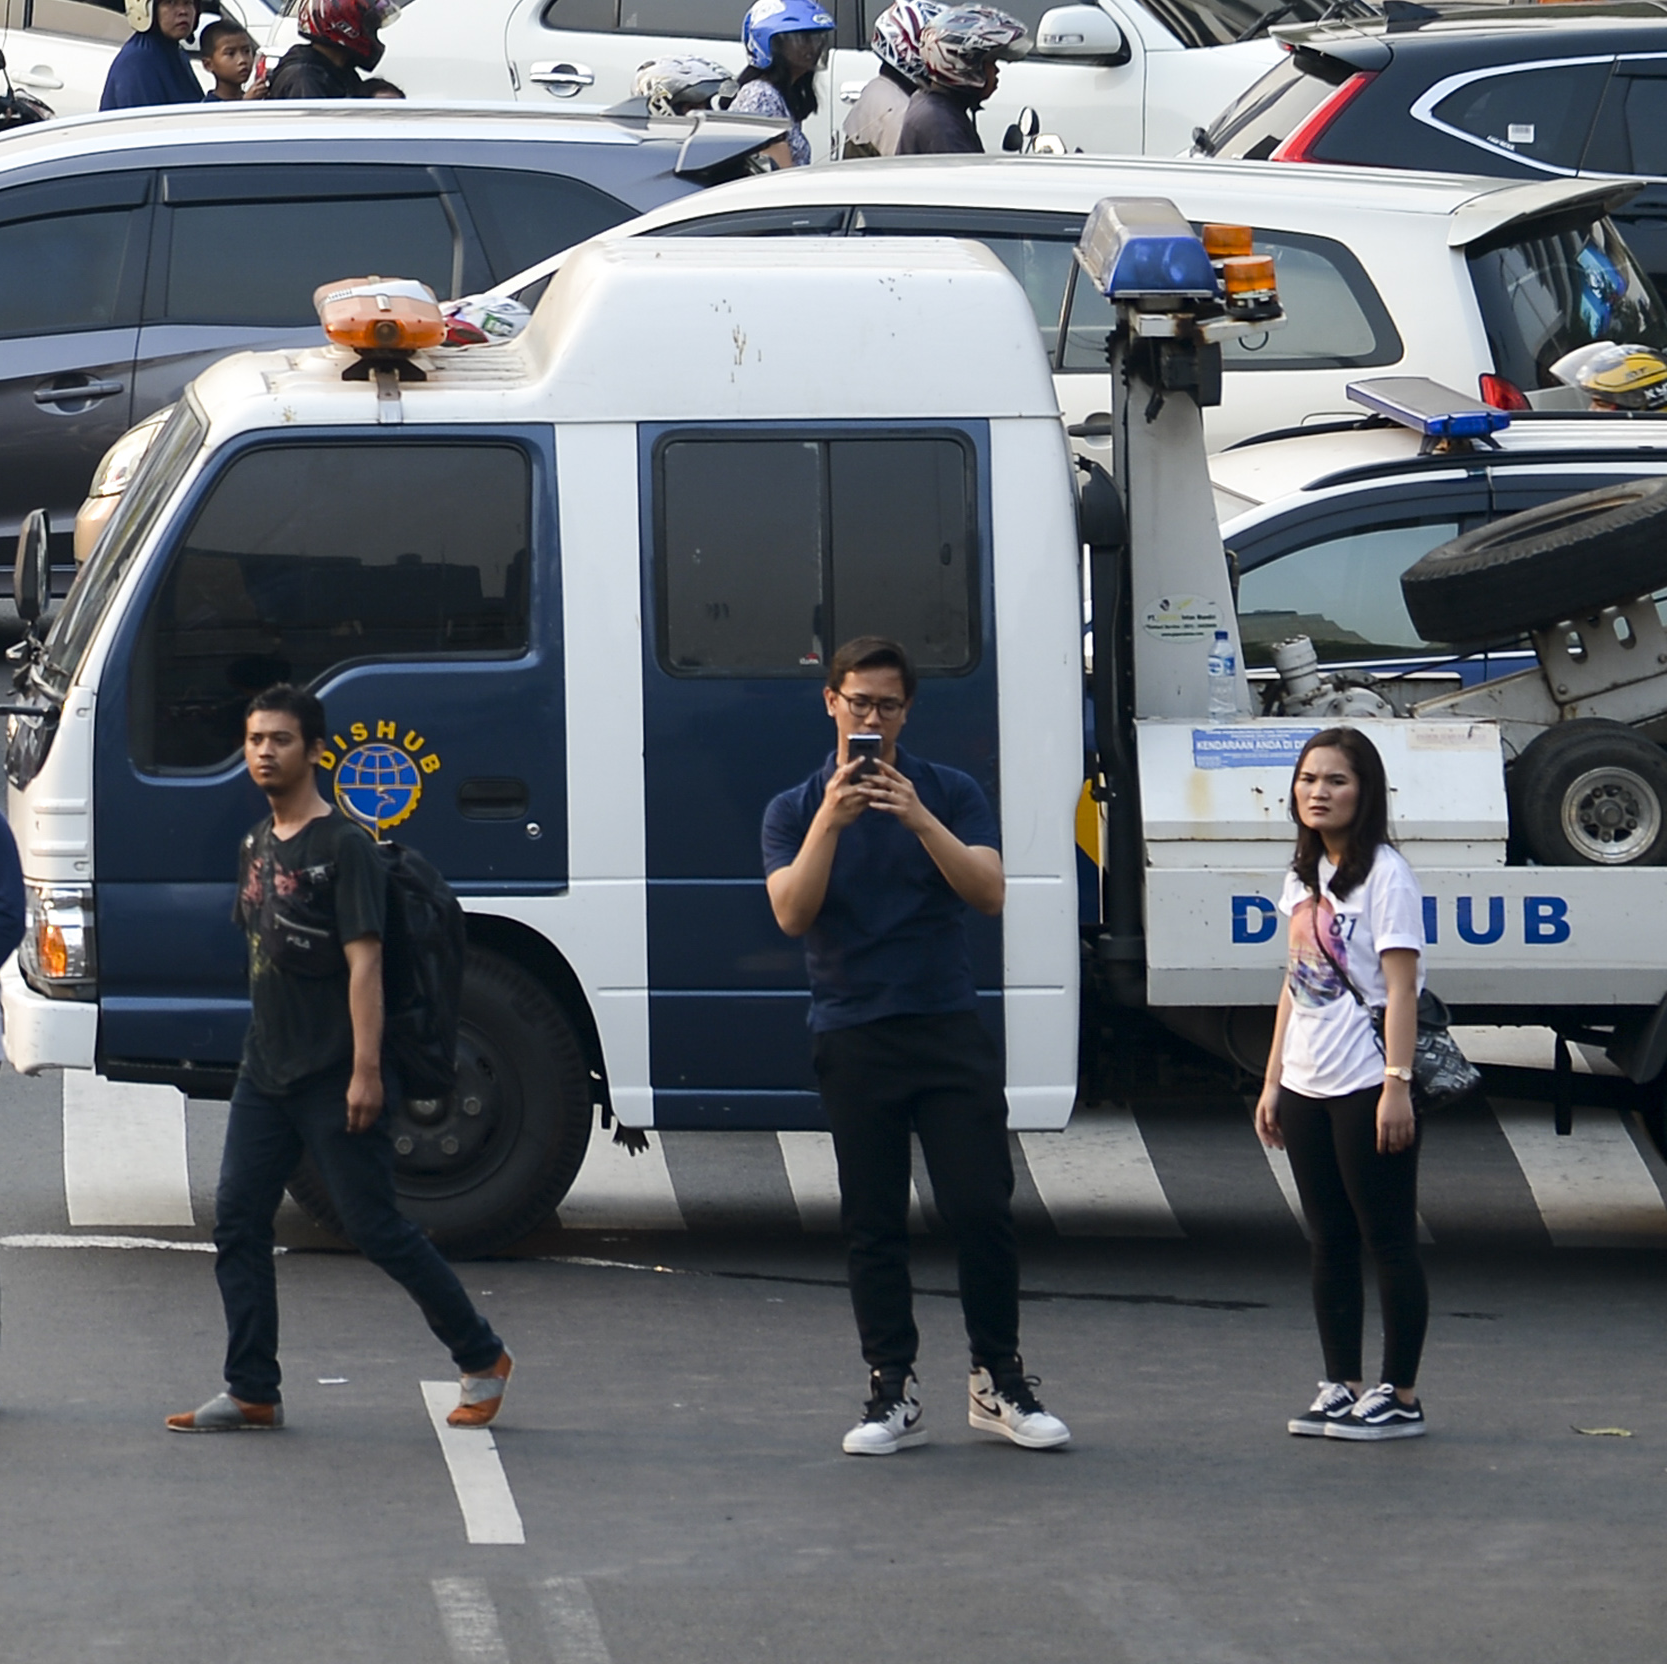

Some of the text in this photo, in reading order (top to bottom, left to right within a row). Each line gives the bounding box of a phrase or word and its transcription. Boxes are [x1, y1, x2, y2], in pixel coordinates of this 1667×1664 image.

[319, 720, 441, 774] DISHUB
[1197, 740, 1253, 751] KENDARAAN
[1256, 739, 1281, 750] ANDA
[1283, 739, 1293, 750] DI
[1329, 913, 1358, 941] 81
